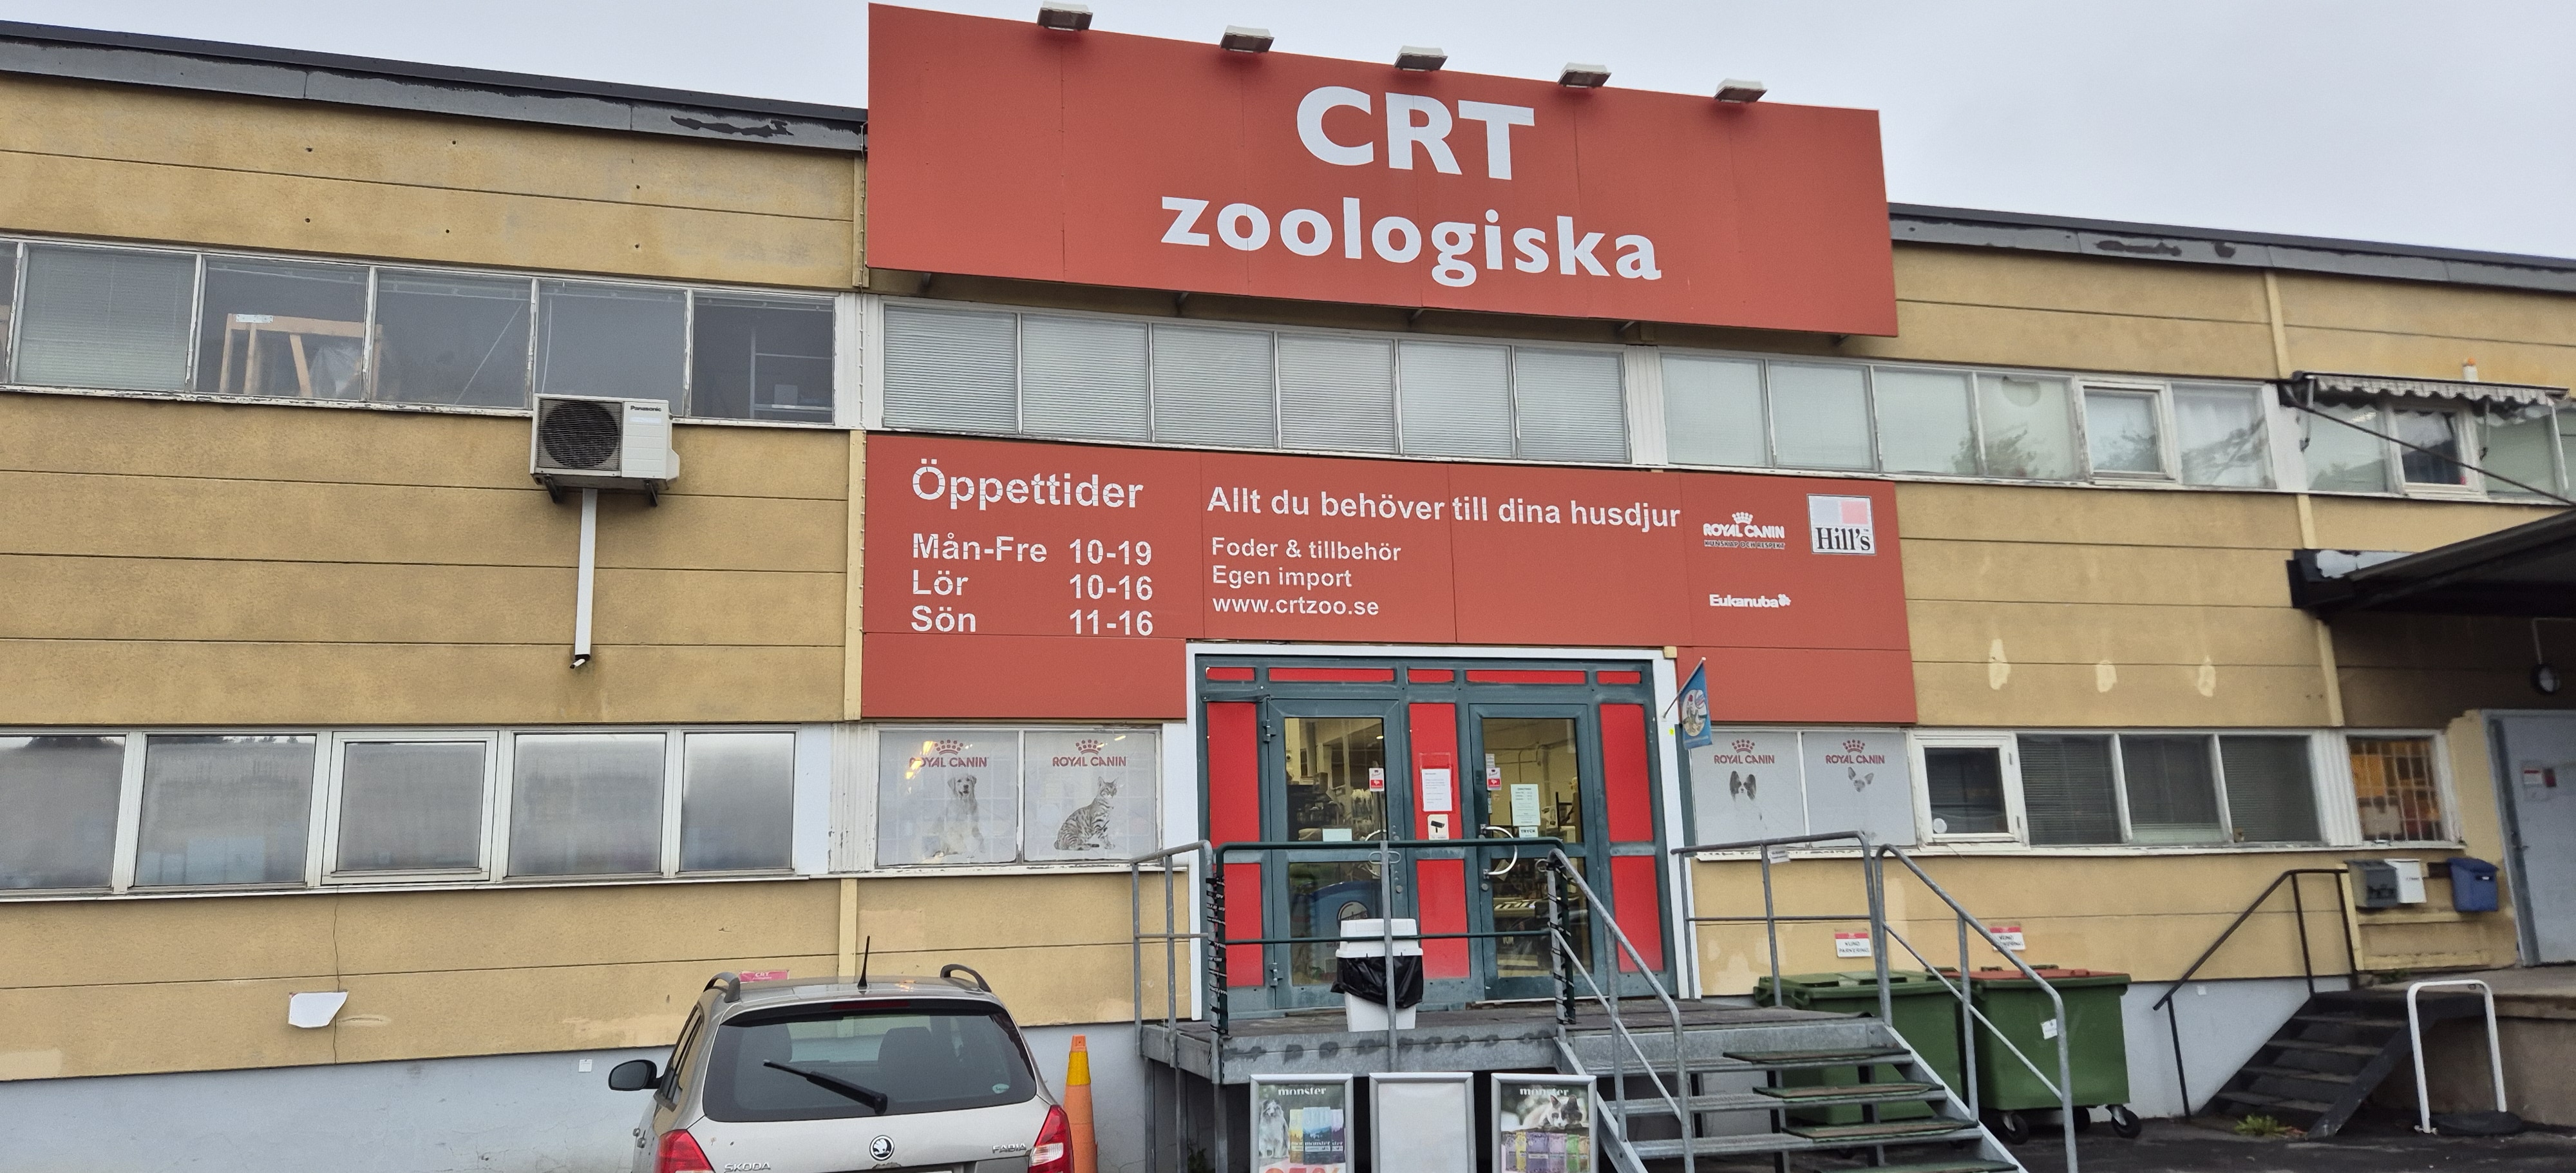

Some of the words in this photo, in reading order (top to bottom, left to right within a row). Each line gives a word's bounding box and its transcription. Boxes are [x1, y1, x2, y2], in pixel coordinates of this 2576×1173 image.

[1297, 86, 1535, 180] CRT
[1161, 196, 1662, 287] zoologiska
[913, 459, 1143, 510] Öppettider
[1208, 487, 1261, 513] Allt
[1272, 490, 1309, 515] du
[1321, 491, 1444, 519] behöver
[1452, 497, 1487, 520] till
[1499, 499, 1560, 523] dina
[1571, 501, 1680, 532] husdjur
[1703, 523, 1743, 537] ROYAL
[1744, 525, 1785, 539] CANIN
[1815, 527, 1871, 551] Hill's
[913, 533, 1047, 562] Mån-Fre
[1070, 539, 1151, 566] 10-19
[1213, 537, 1278, 557] Foder
[1286, 540, 1302, 557] &
[1309, 541, 1401, 561] tillbehör
[913, 570, 969, 595] Lör
[1070, 575, 1152, 600] 10-16
[1213, 566, 1269, 588] Egen
[1279, 567, 1352, 590] import
[1213, 596, 1378, 615] www.crtzoo.se
[1709, 594, 1779, 607] Eukanuba
[911, 606, 976, 632] Sön
[1070, 609, 1153, 636] 11-16
[949, 757, 987, 768] CANIN
[1052, 756, 1088, 767] ROYAL
[1090, 756, 1126, 767] CANIN
[1714, 754, 1743, 765] ROYAL
[1745, 754, 1775, 765] CANIN
[1825, 754, 1854, 765] ROYAL
[1855, 754, 1885, 765] CANIN
[1278, 1087, 1326, 1096] monster
[992, 1143, 1026, 1153] FABIA
